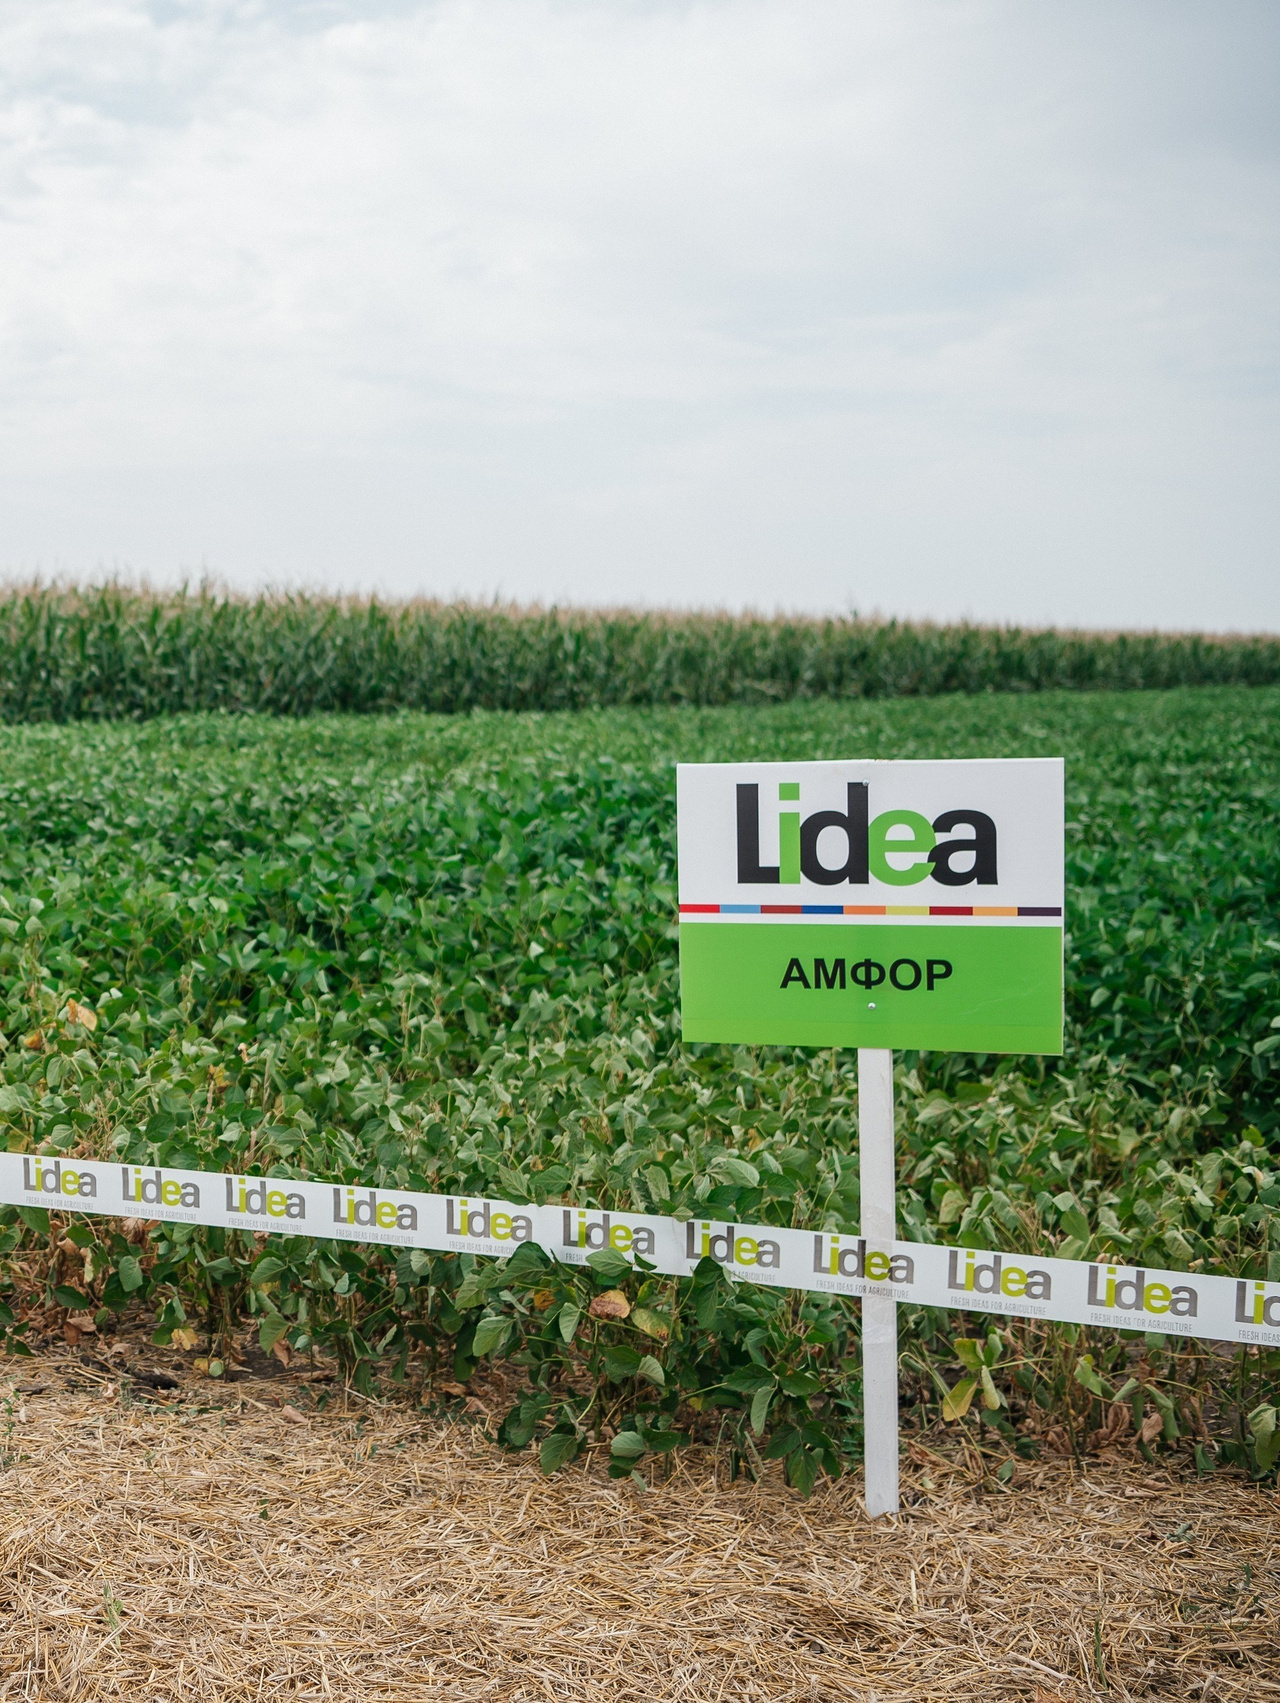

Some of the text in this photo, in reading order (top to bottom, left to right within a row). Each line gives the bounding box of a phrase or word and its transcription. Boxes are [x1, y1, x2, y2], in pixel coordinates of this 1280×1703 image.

[736, 781, 998, 886] Lidea
[779, 957, 953, 991] АМФОР
[23, 1157, 97, 1198] Lidea
[121, 1167, 200, 1208] Lidea
[225, 1177, 306, 1219] Lidea
[333, 1188, 418, 1231] Lidea
[446, 1199, 533, 1242] Lidea
[494, 1246, 515, 1255] AGRICU
[562, 1210, 655, 1255] Lidea
[686, 1221, 781, 1268] Lidea
[813, 1235, 915, 1284] Lidea
[948, 1250, 1052, 1300] Lidea
[816, 1279, 910, 1299] FRESH IDEAS FOR AGRICULTURE
[951, 1296, 1046, 1315] FRESH IDEAS FOR AGRICULTURE
[1087, 1265, 1198, 1317] Lidea
[1090, 1313, 1110, 1324] FRESH
[1113, 1315, 1131, 1326] IDEAS
[1148, 1319, 1193, 1333] AGRICULTURE
[1238, 1330, 1280, 1343] FRESH IDEAS
